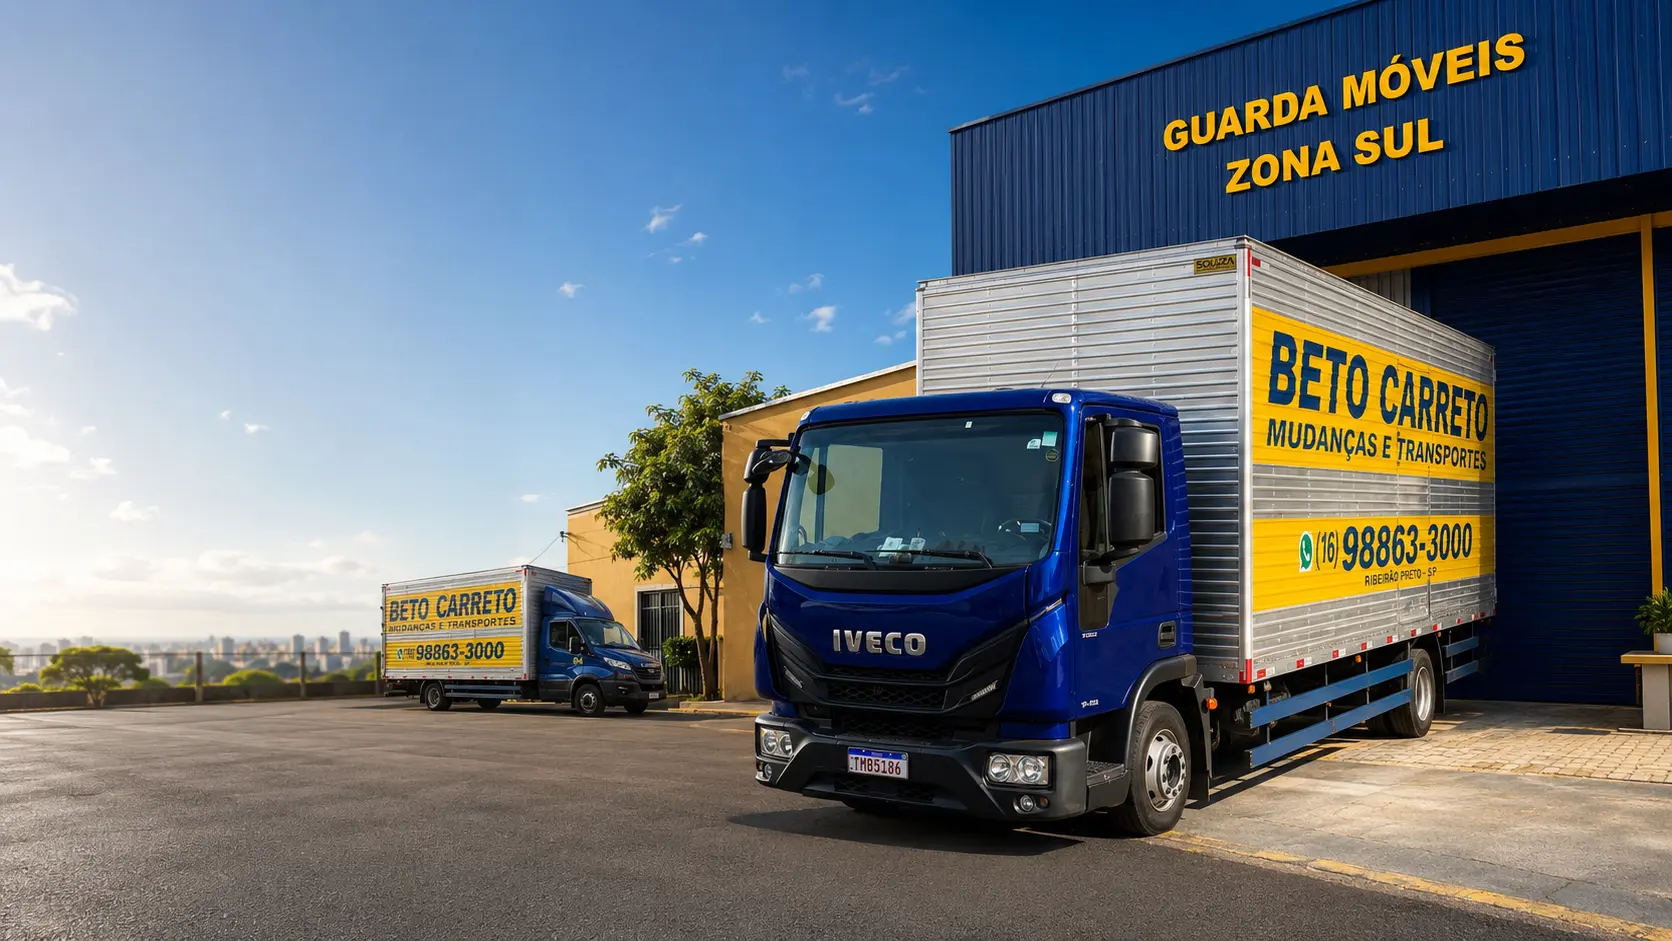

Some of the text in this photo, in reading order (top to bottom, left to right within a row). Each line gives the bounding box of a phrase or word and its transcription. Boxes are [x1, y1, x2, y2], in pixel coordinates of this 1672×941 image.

[1163, 32, 1526, 151] GUARDA MÓVEIS
[1225, 118, 1444, 194] ZONA SUL
[1268, 330, 1488, 442] BETO CARRETO
[1266, 418, 1487, 471] MUDANÇAS E TRANSPORTES
[1315, 522, 1473, 572] (16) 98863-3000
[1400, 568, 1422, 581] PRETO
[1427, 566, 1437, 577] SP
[389, 587, 517, 622] BETO CARRETO
[439, 621, 444, 630] E
[448, 616, 517, 629] TRANSPORTES
[416, 641, 505, 660] 98863-3000
[832, 629, 926, 656] IVECO
